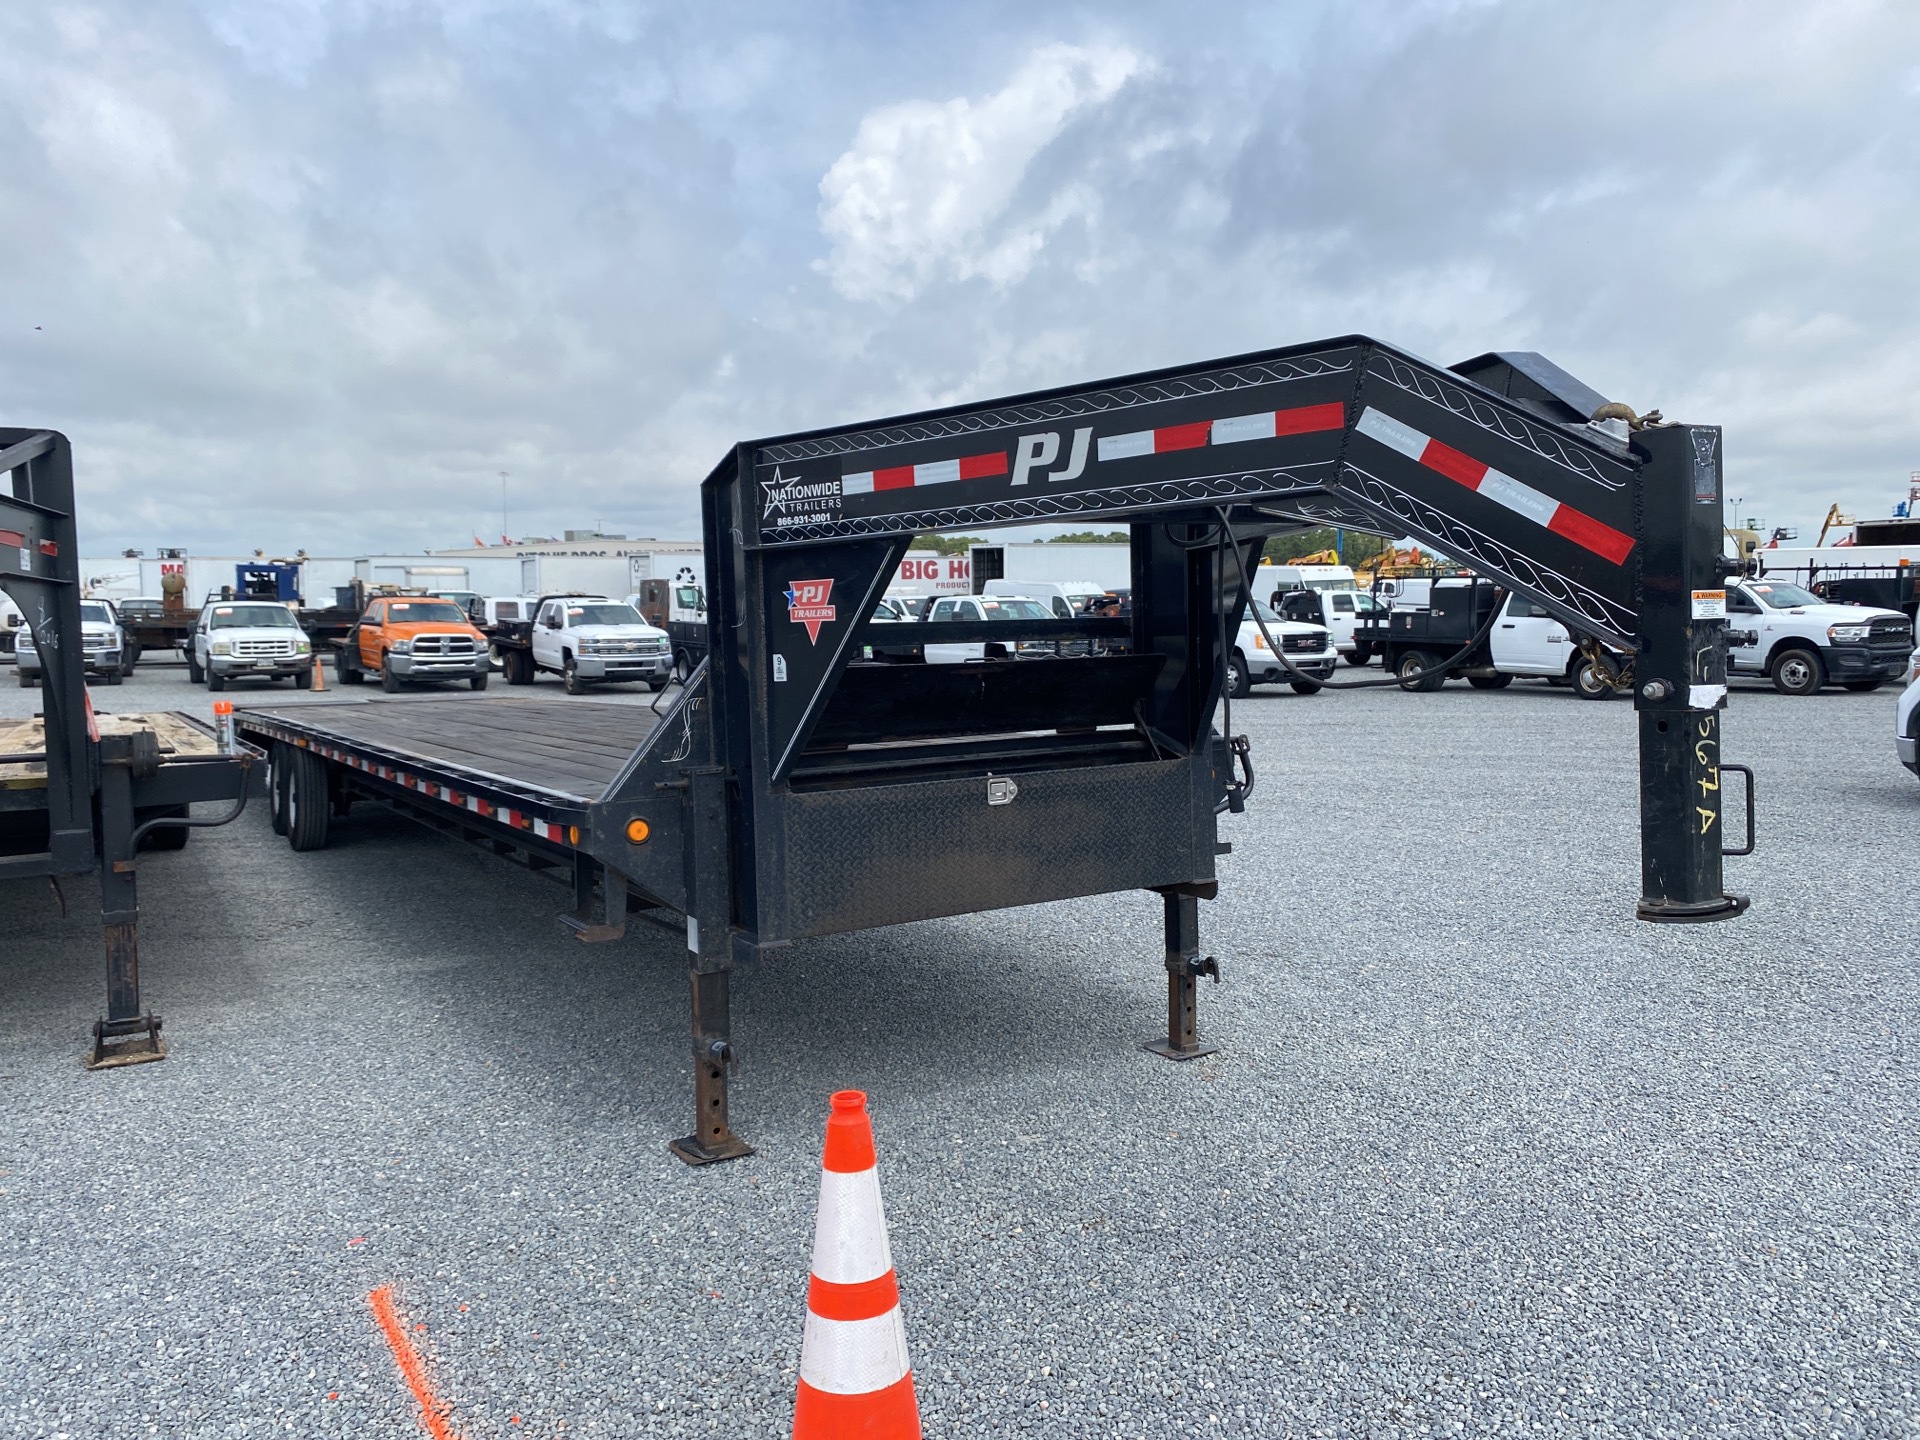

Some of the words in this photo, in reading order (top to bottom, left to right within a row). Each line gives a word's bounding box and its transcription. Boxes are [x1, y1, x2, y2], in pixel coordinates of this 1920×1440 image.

[1010, 426, 1094, 487] PJ
[771, 481, 841, 502] NATIONWIDE
[789, 498, 842, 513] TRAILERS
[777, 512, 831, 526] 866-931-3001
[901, 559, 939, 580] BIG
[801, 585, 824, 603] PJ
[793, 608, 833, 618] TRAILERS
